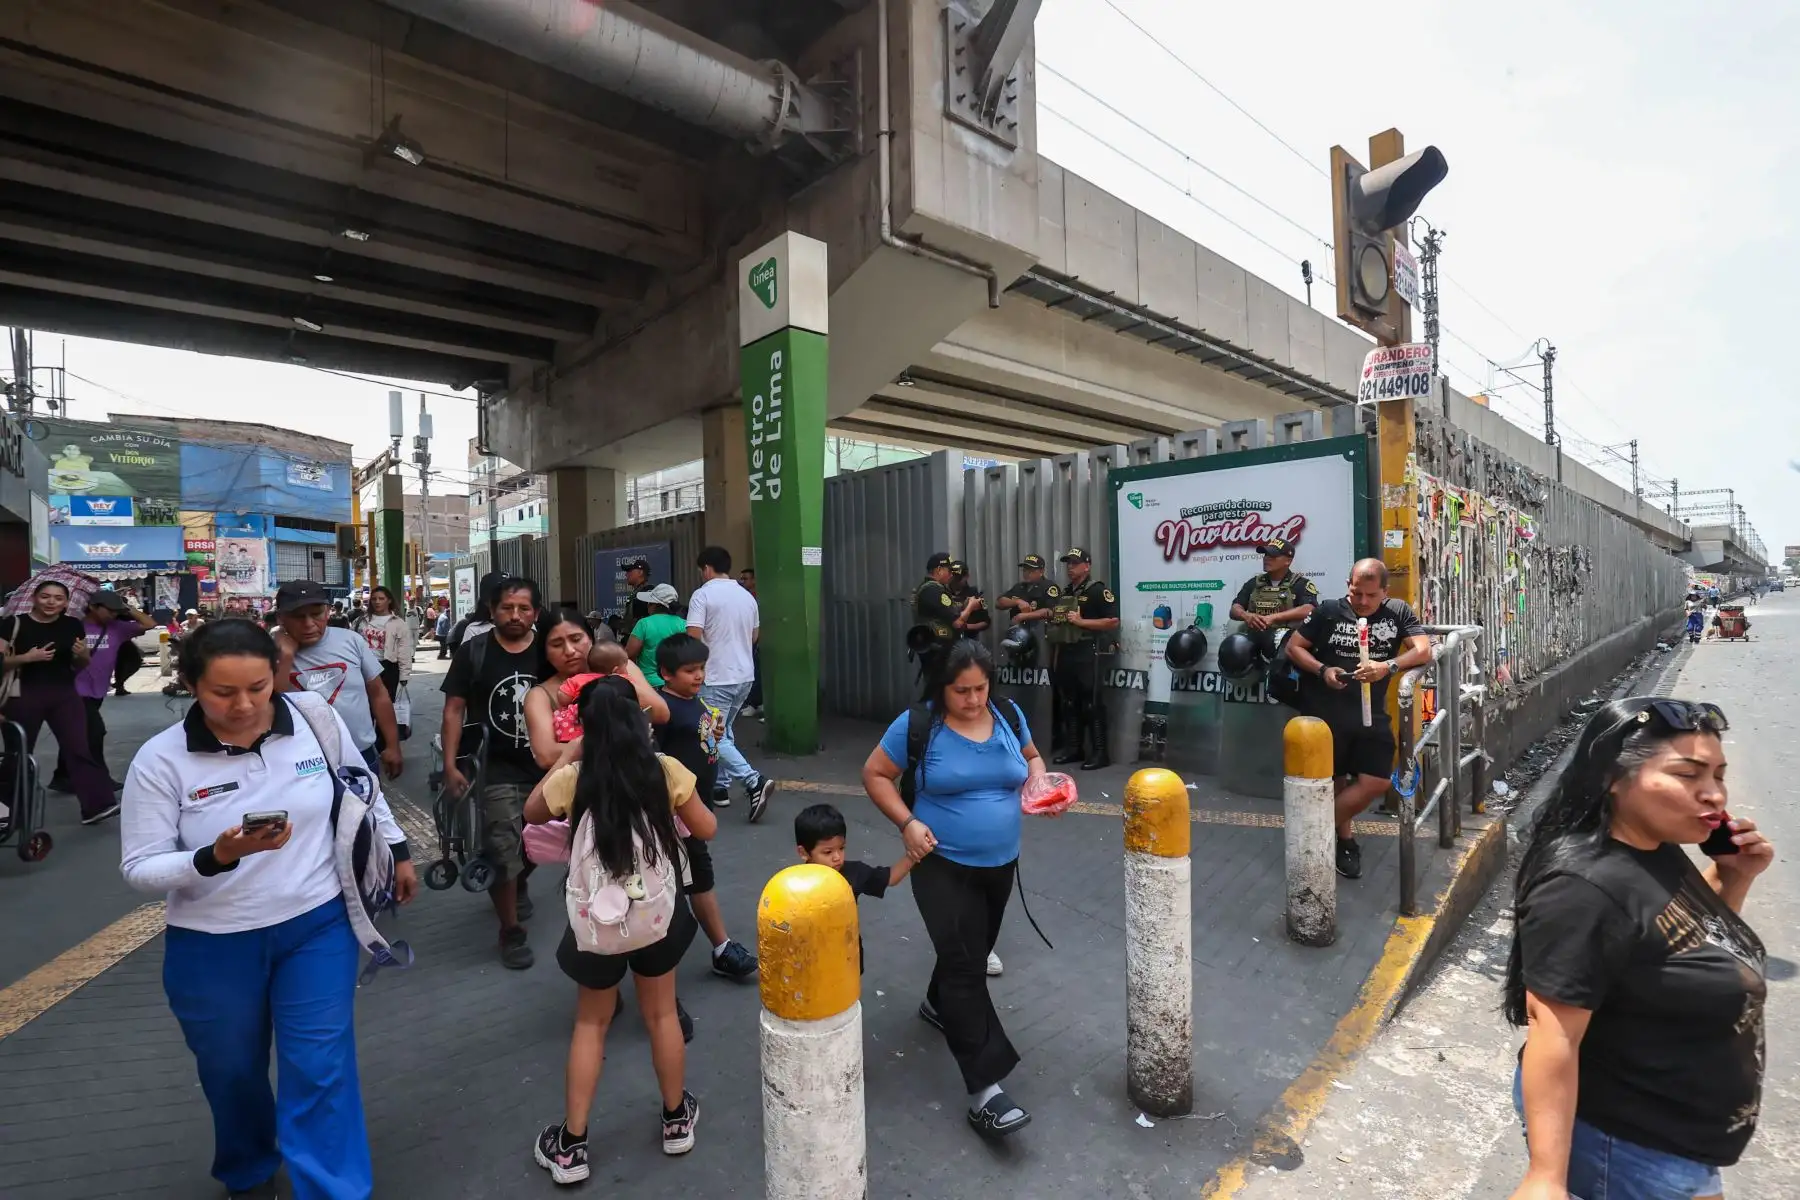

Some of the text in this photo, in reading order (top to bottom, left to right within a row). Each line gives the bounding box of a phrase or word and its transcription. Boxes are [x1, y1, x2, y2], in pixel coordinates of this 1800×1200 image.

[767, 280, 775, 303] 1
[1360, 372, 1429, 401] 921449108
[766, 351, 782, 500] de Lima
[90, 434, 133, 442] CAMBIA
[153, 438, 171, 448] DÍA
[749, 394, 764, 501] Metro
[1180, 499, 1272, 518] Recomendaciones
[1202, 509, 1247, 523] para esta
[1156, 512, 1304, 557] Navidad
[187, 541, 215, 549] BASA
[1192, 555, 1218, 564] segura
[310, 670, 333, 683] NIKE
[1103, 669, 1144, 689] LICIA
[295, 756, 325, 771] MINSA
